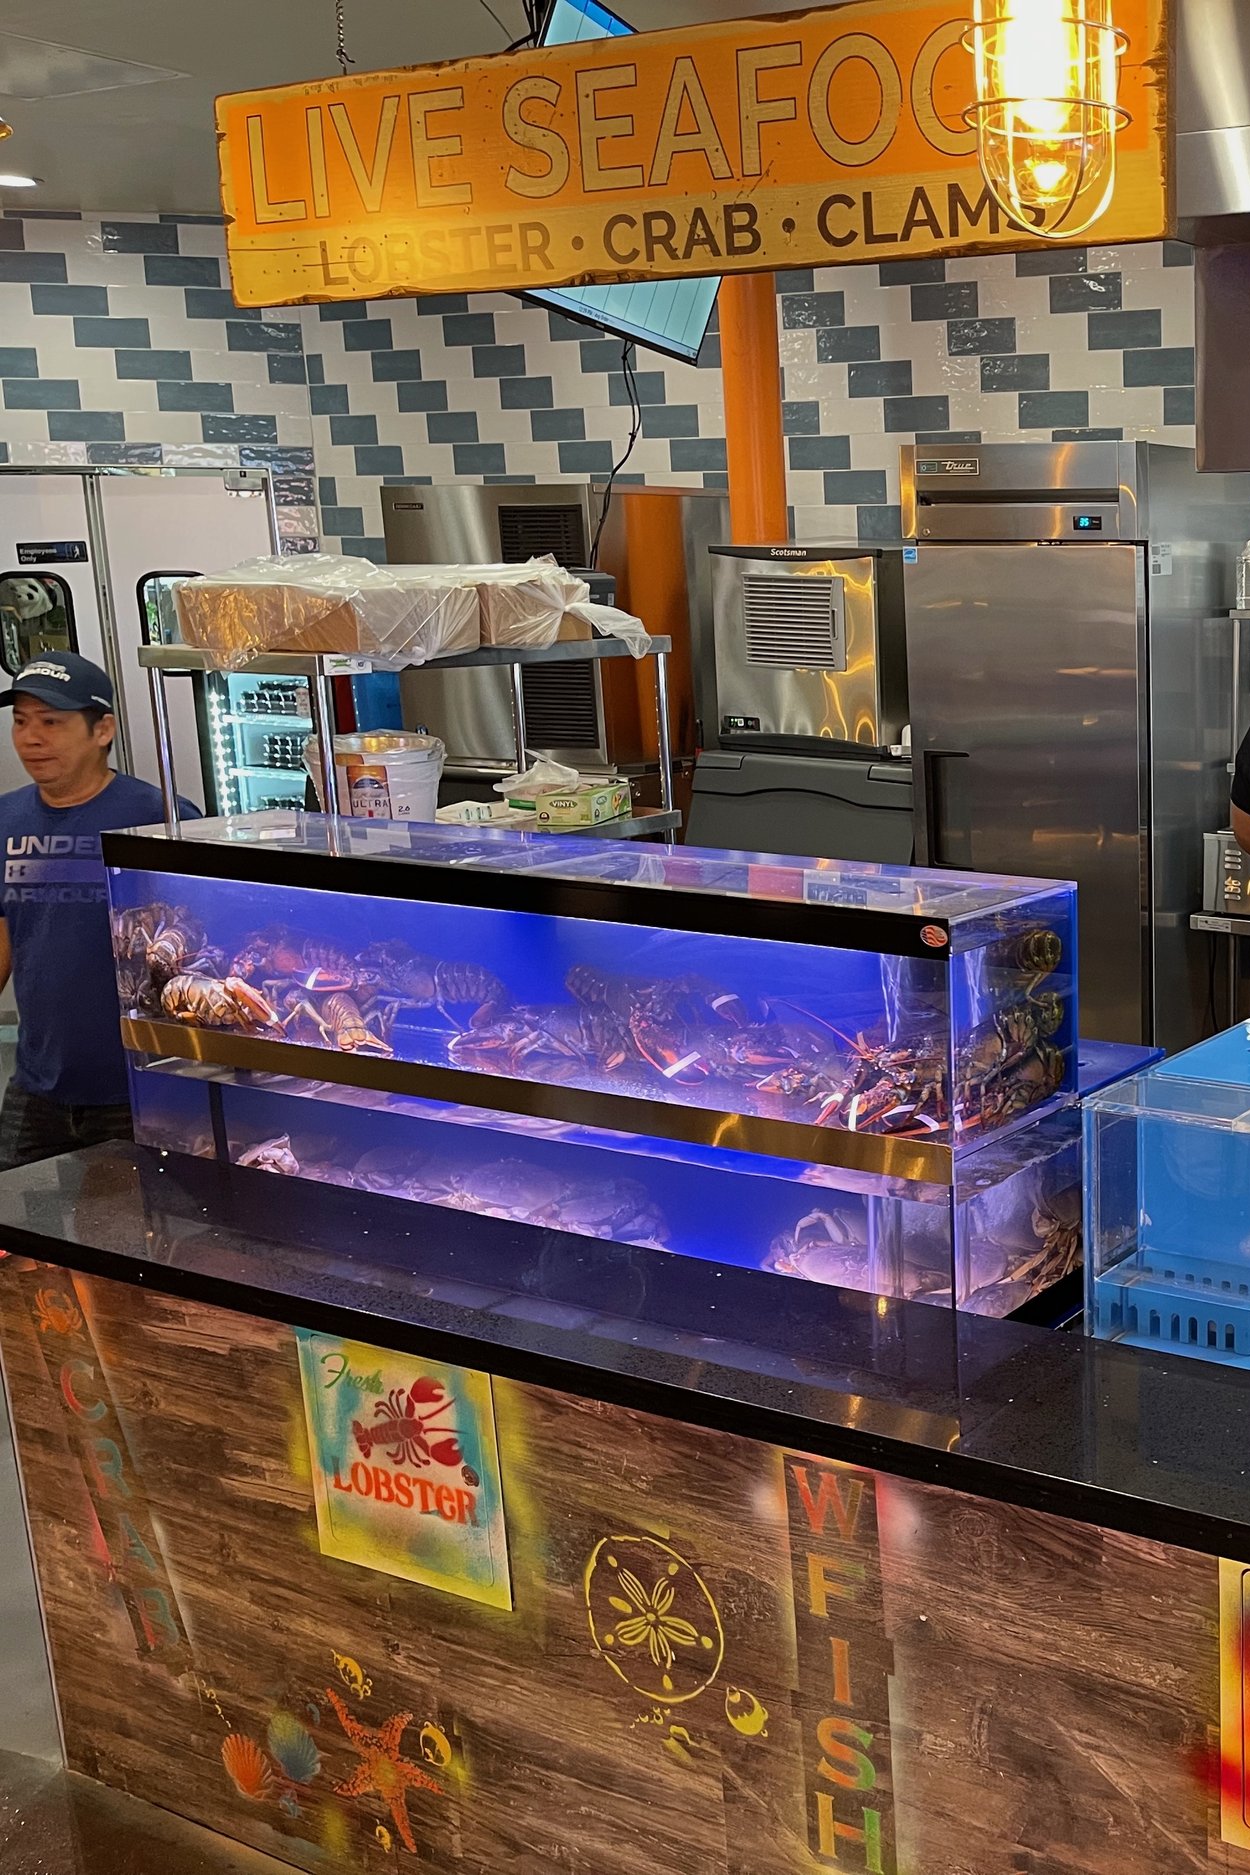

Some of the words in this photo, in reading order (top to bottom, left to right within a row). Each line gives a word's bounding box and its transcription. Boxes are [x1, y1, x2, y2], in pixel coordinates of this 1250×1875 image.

[246, 86, 474, 225] LIVE
[502, 17, 1121, 199] SEAFOO
[319, 219, 553, 286] LOBSTER
[602, 201, 763, 265] CRAB
[20, 548, 57, 556] Employees
[770, 548, 807, 557] Scotsman
[353, 800, 389, 808] ULTRA
[552, 800, 575, 808] VINYL
[7, 835, 101, 855] UNDE
[320, 1352, 385, 1395] Fresh
[331, 1455, 481, 1528] LOBSTER
